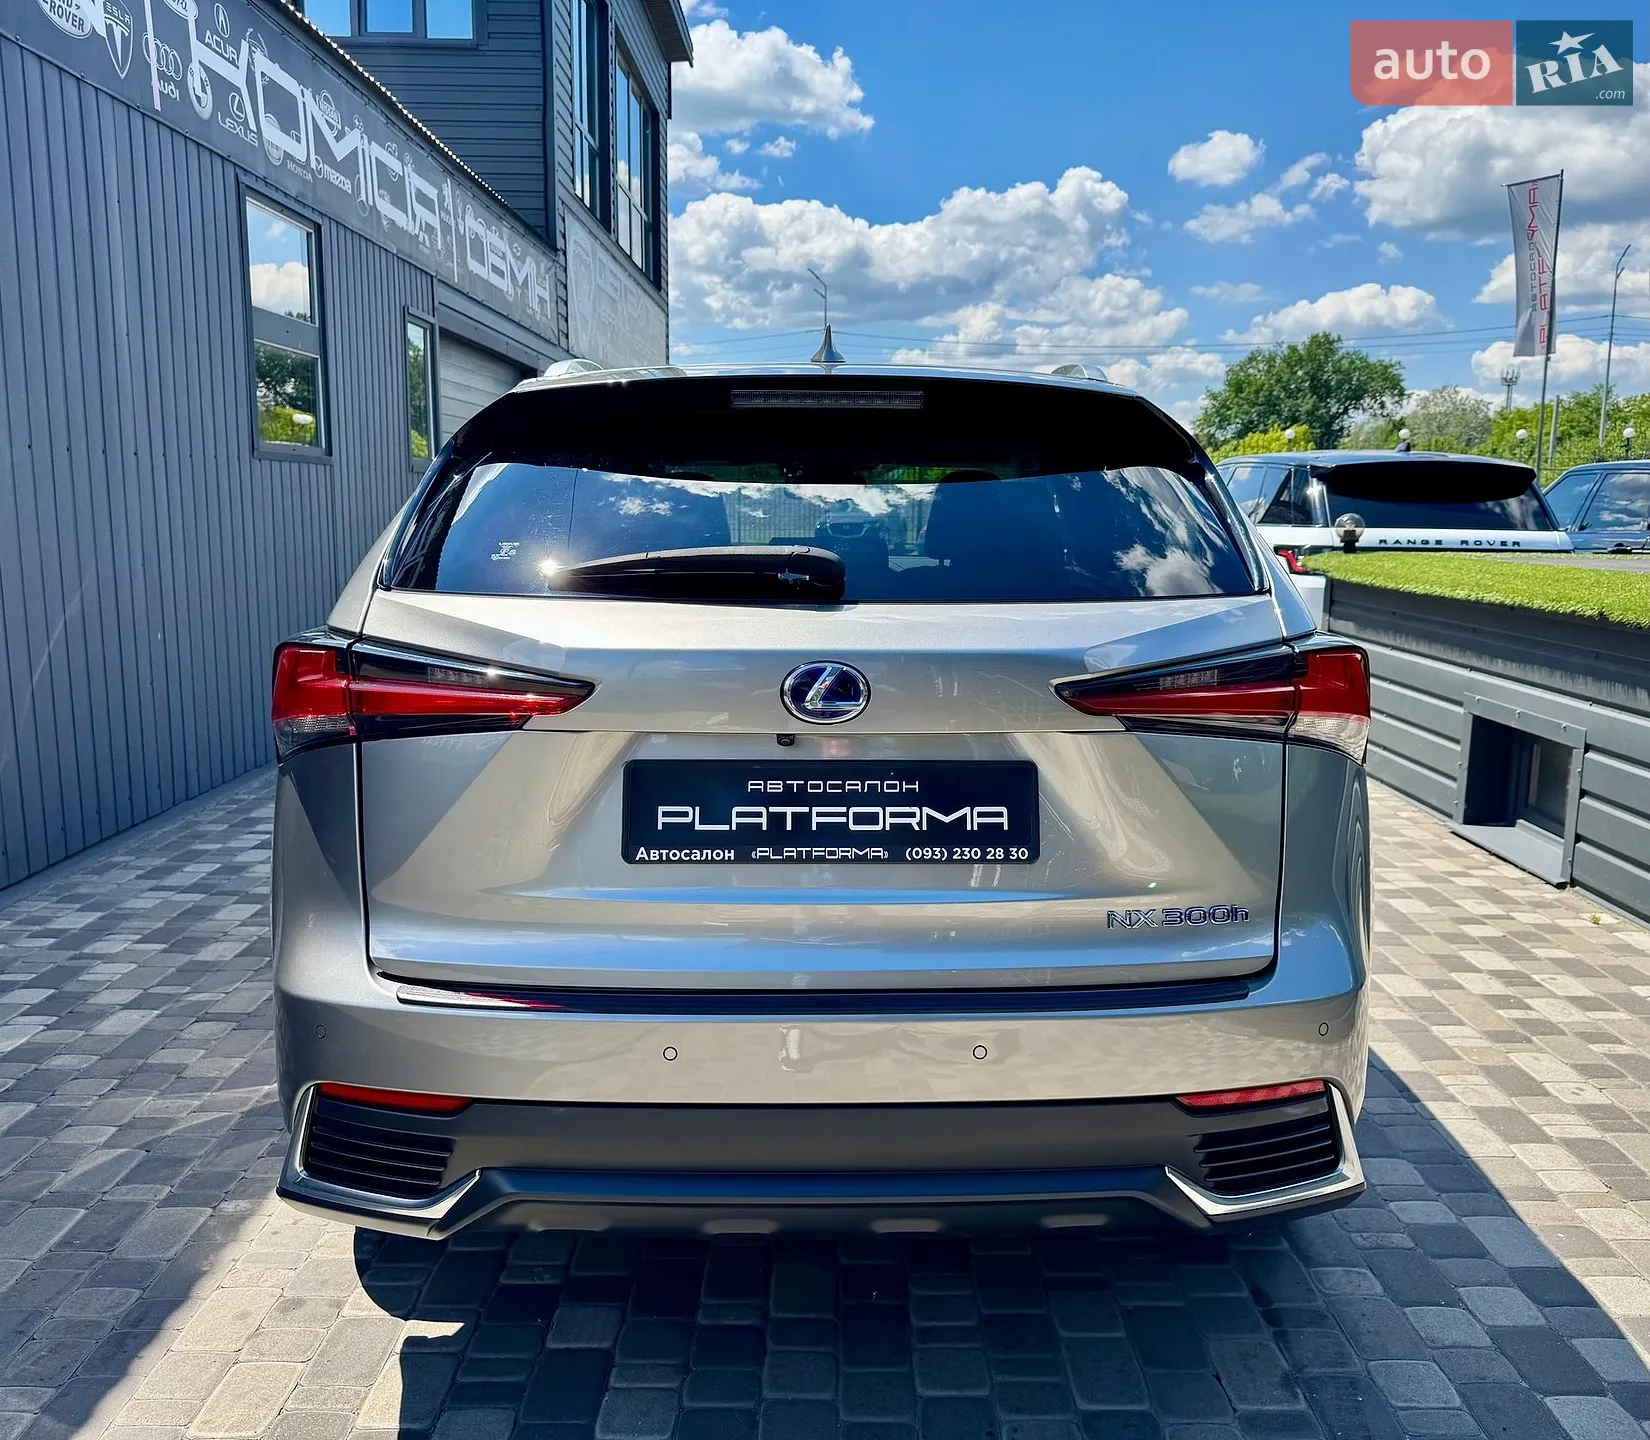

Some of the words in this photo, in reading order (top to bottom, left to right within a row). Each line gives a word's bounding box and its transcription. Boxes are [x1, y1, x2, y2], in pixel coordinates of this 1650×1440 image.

[49, 1, 85, 33] ROVER
[104, 1, 131, 24] ESLA
[205, 30, 241, 67] ACUR
[217, 111, 259, 148] LEXUS
[286, 159, 314, 183] HONDA
[323, 163, 352, 195] mazda
[1460, 539, 1521, 548] ROVER
[747, 780, 919, 793] АВТОСАЛОН
[657, 806, 1008, 831] PLATFORMA
[635, 846, 735, 862] Автосалон
[905, 847, 948, 862] (093)
[952, 847, 981, 861] 230
[985, 847, 1004, 861] 28
[1009, 847, 1029, 861] 30
[1106, 909, 1159, 930] NX
[1161, 904, 1250, 928] 300h
